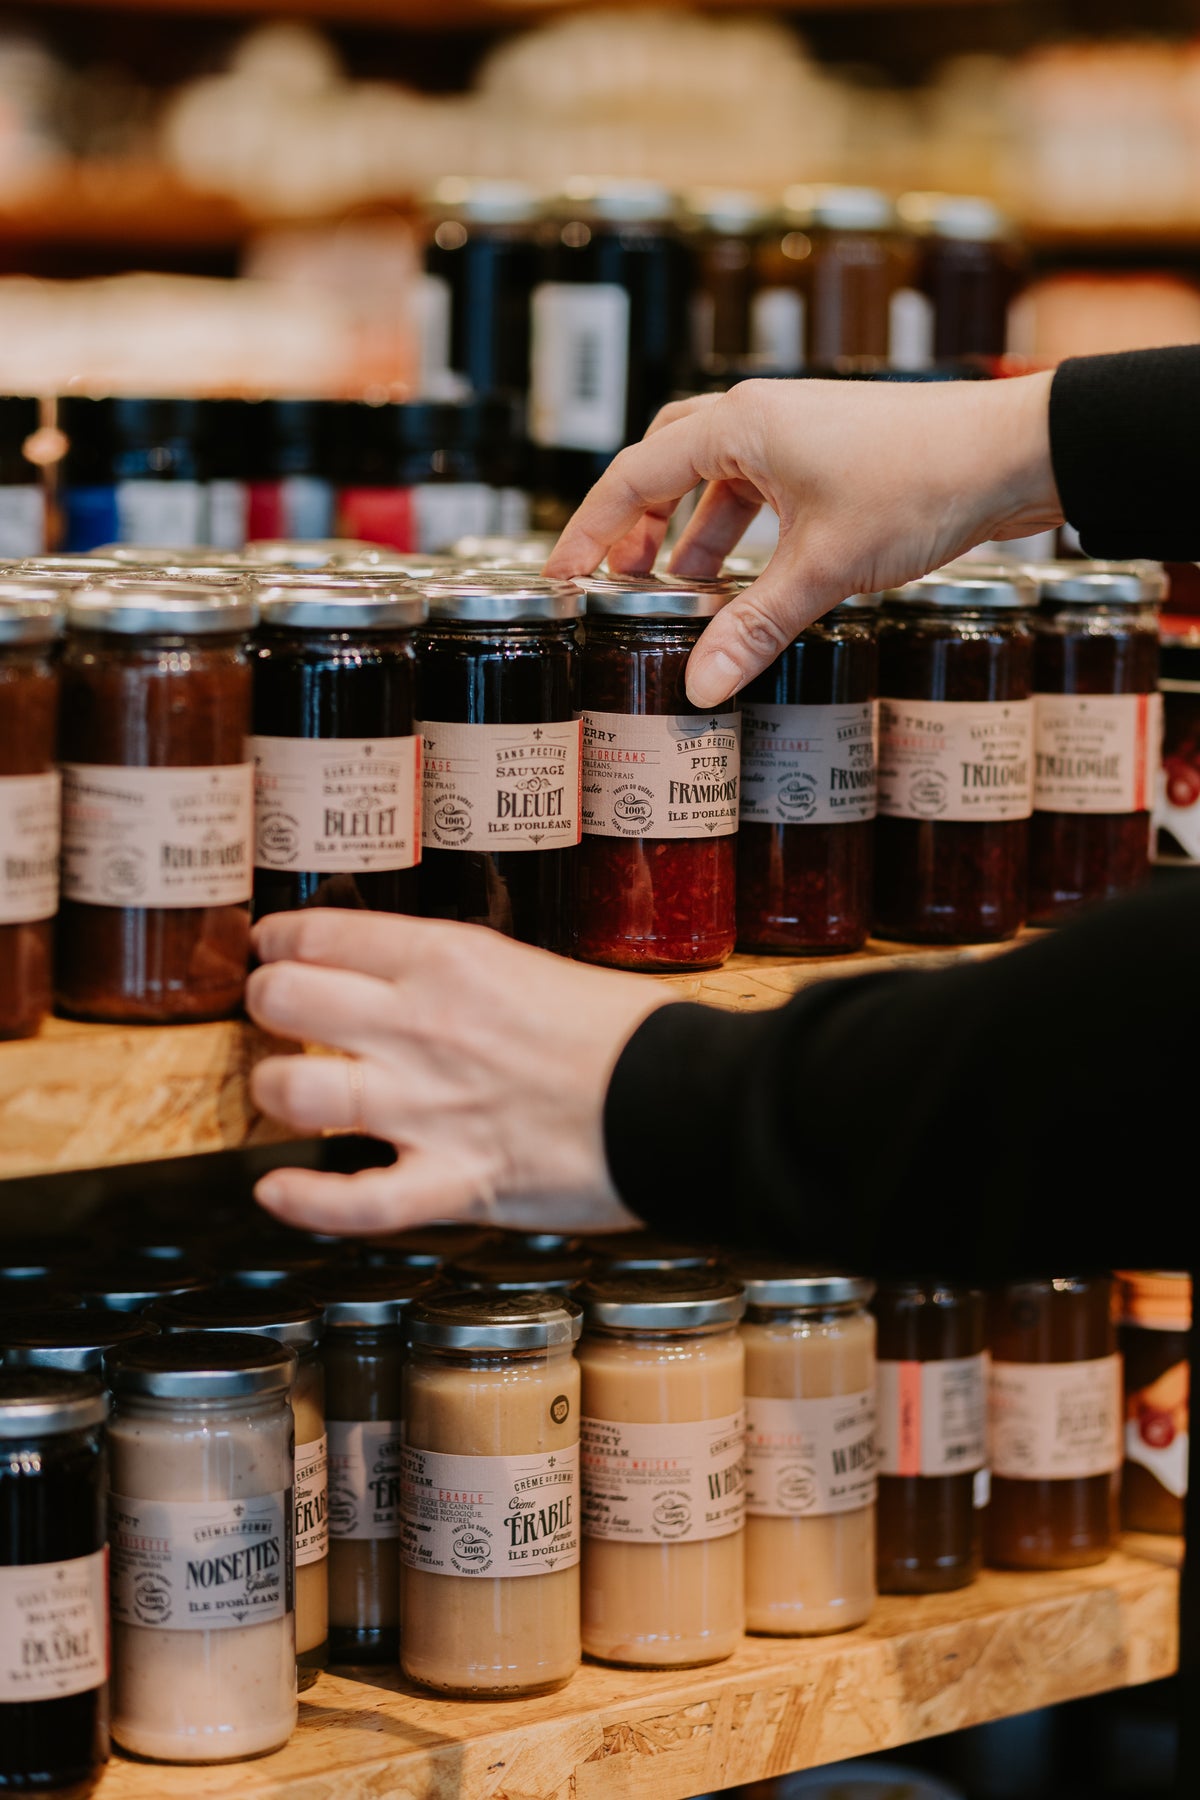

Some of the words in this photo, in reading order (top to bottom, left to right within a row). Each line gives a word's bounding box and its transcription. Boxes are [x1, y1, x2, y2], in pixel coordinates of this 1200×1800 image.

[677, 739, 702, 752] SANS
[707, 738, 735, 749] PECTINE
[496, 749, 524, 761] SANS
[530, 747, 567, 758] PECTINE
[691, 755, 728, 770] PURE
[496, 765, 565, 778] SAUVAGE
[668, 775, 738, 805] FRAMBOISE
[496, 787, 565, 818] BLEUET
[624, 805, 646, 815] 100%
[668, 811, 688, 822] ÎLE
[692, 807, 737, 820] D'ORLÉANS
[488, 822, 509, 833] ÎLE
[514, 819, 572, 831] D'ORLÉANS
[514, 1475, 544, 1492] CRÈME
[554, 1473, 574, 1483] POMME
[508, 1496, 536, 1510] Crème
[504, 1495, 573, 1547] ÉRABLE
[194, 1524, 227, 1542] CRÈME
[464, 1545, 485, 1554] 100%
[508, 1549, 528, 1561] ÎLE
[532, 1539, 577, 1557] D'ORLÉANS
[185, 1537, 280, 1591] NOISETTES
[189, 1601, 211, 1612] ÎLE
[216, 1591, 280, 1611] D'ORLÉANS
